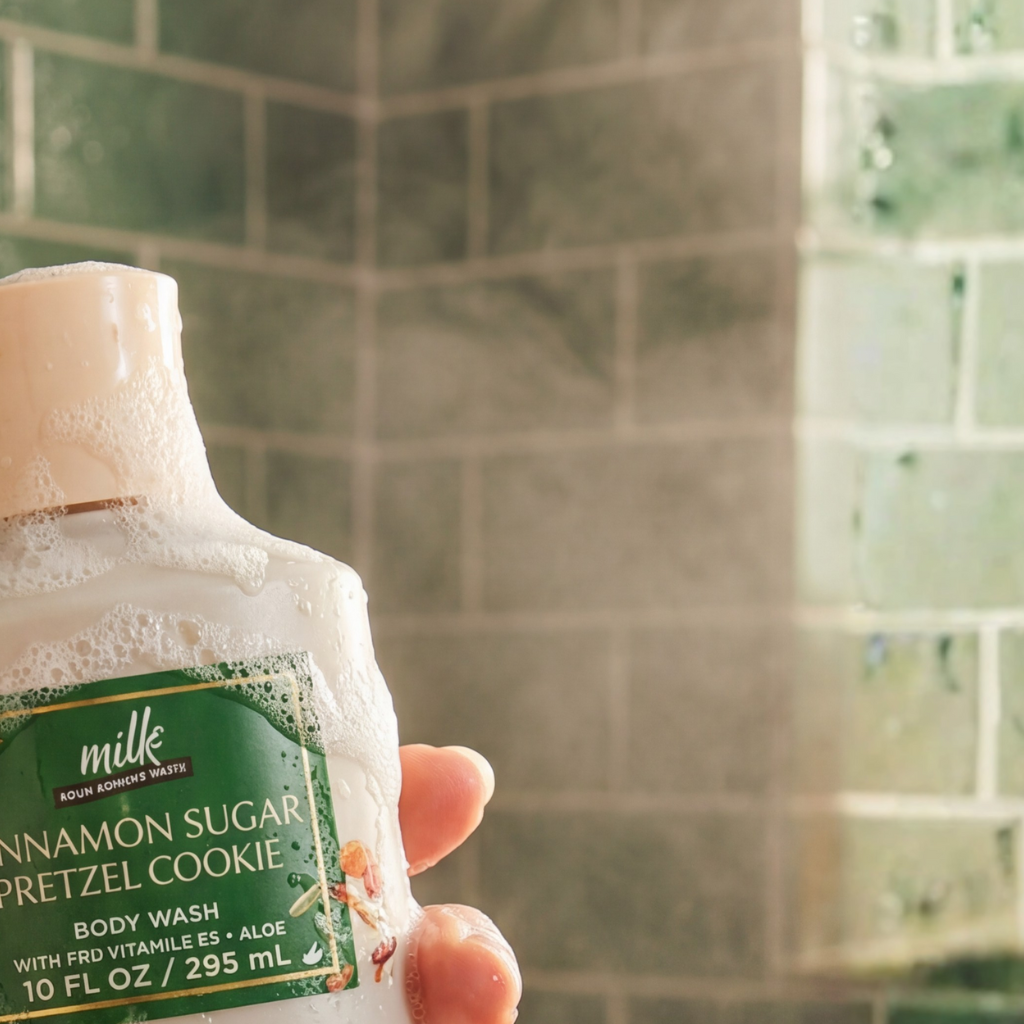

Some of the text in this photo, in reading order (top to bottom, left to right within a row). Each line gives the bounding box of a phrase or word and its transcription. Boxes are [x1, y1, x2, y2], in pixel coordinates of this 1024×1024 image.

[183, 793, 305, 840] SUGAR
[148, 838, 285, 886] COOKIE
[73, 901, 220, 940] BODY WASH
[12, 920, 287, 974] WITH FRD VITAMILE ES ALOE
[22, 977, 55, 1003] 10
[63, 971, 101, 998] FL
[107, 963, 153, 992] OZ
[184, 950, 240, 981] 295
[248, 943, 292, 971] mL
